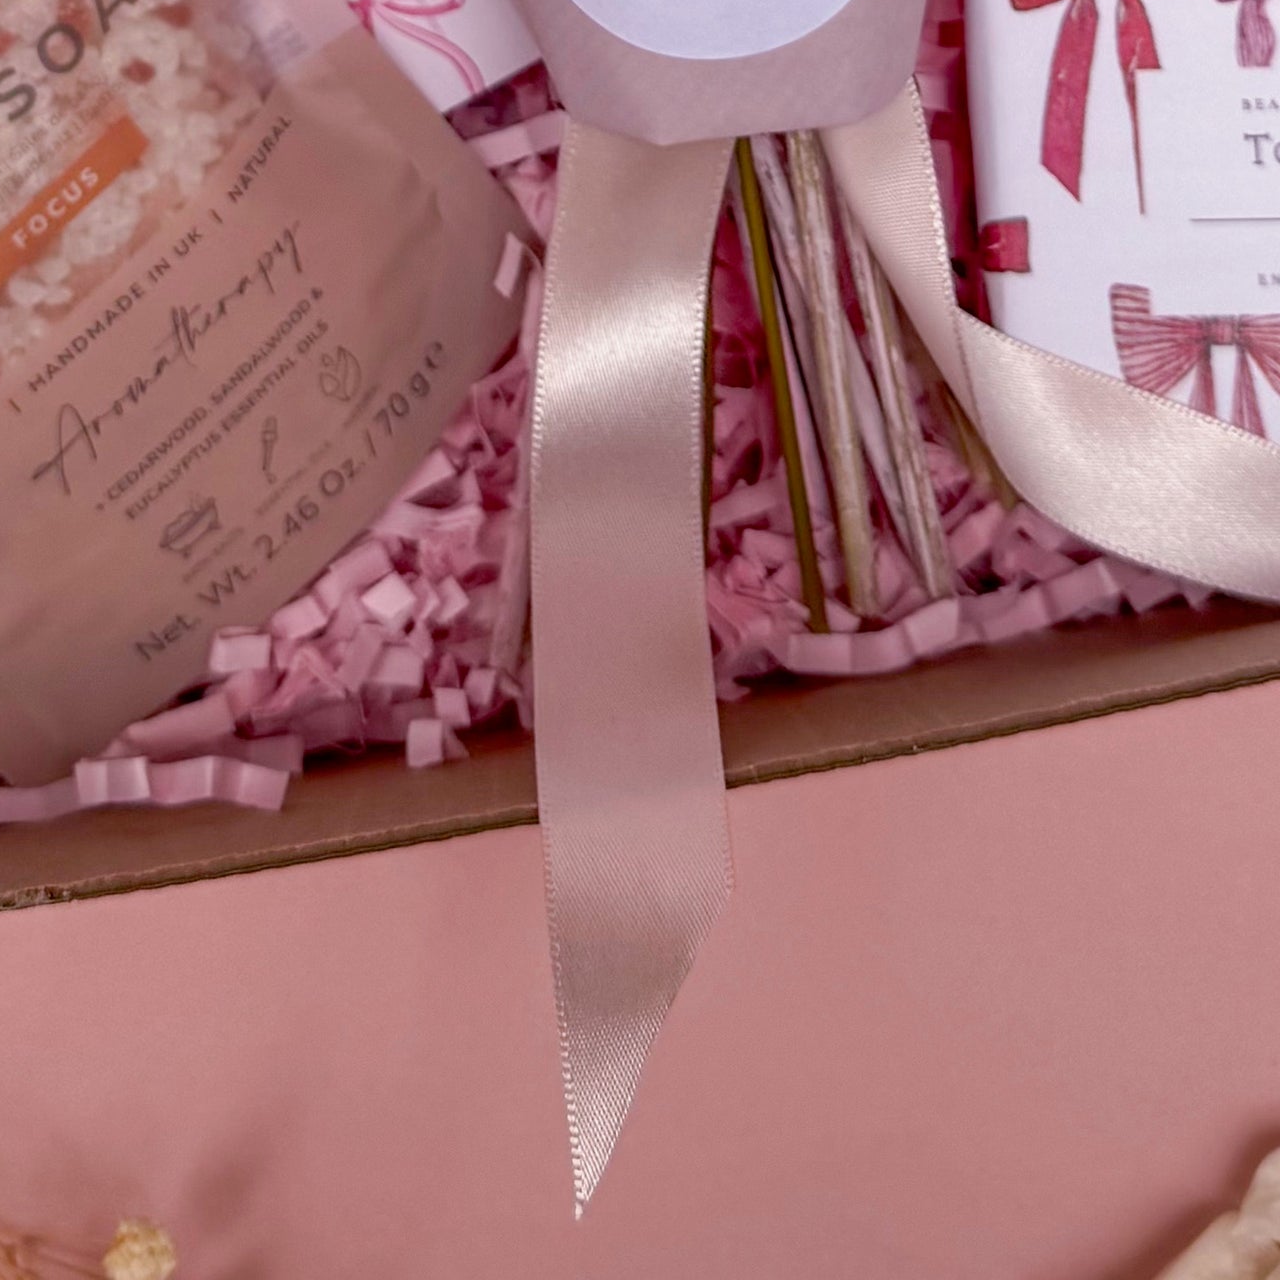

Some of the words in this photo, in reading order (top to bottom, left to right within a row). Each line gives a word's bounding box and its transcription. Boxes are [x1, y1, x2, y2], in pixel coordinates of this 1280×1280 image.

[10, 166, 98, 249] FOCUS
[27, 281, 145, 392] HANDMADE
[147, 256, 171, 283] IN
[172, 226, 203, 257] UK
[226, 115, 292, 203] NATURAL
[27, 219, 303, 496] Aromatherapy
[123, 430, 222, 521] EUCALYPTUS
[219, 356, 297, 433] ESSENTIAL
[295, 318, 328, 354] OILS
[208, 298, 311, 405] SANDALWOOD
[252, 494, 320, 563] 2.46
[317, 457, 366, 499] Oz.
